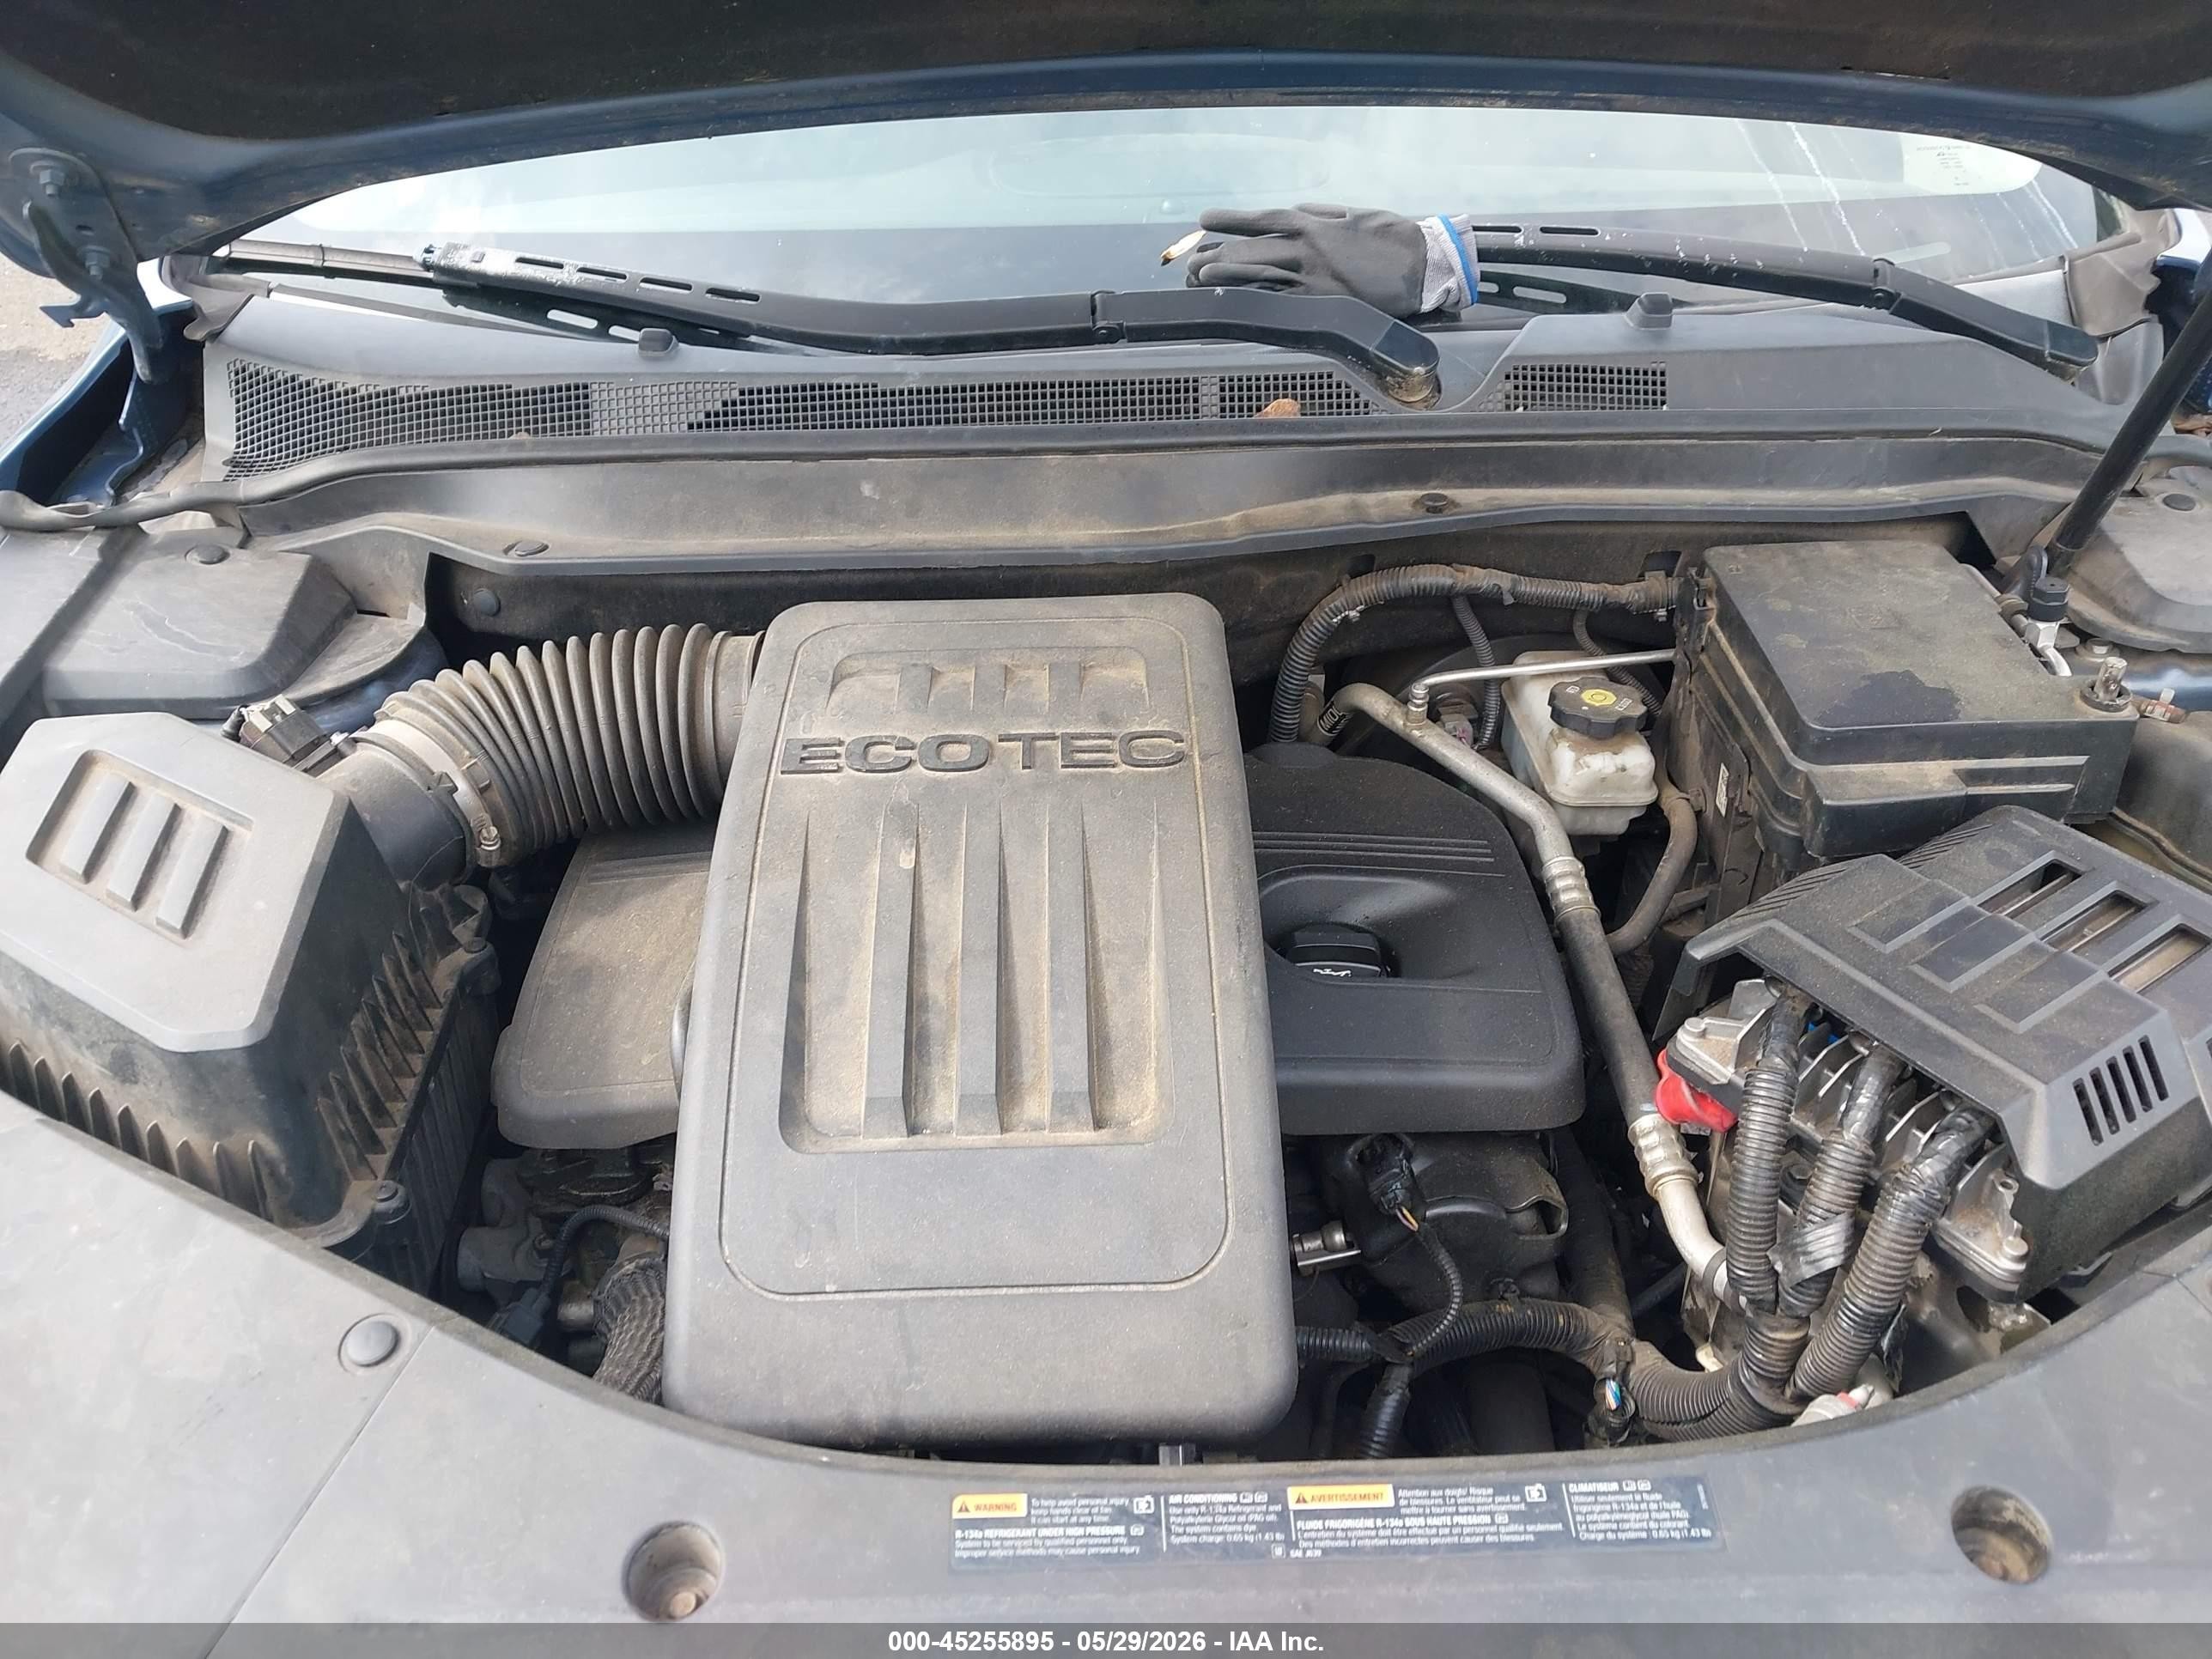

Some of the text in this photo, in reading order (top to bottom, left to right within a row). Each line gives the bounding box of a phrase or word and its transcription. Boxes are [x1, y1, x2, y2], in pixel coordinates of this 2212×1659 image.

[780, 729, 1185, 775] ECOTEC
[1569, 1481, 1620, 1493] CLIMATISEUR
[1169, 1492, 1237, 1504] AIR CONDITIONING
[1310, 1492, 1384, 1503] AVERTISSEMENT
[975, 1502, 1018, 1512] WARNING
[1297, 1520, 1323, 1530] FLUIDE
[1376, 1518, 1404, 1528] R-134a
[1404, 1516, 1425, 1528] SOUS
[1426, 1516, 1451, 1526] HAUTE
[1452, 1514, 1492, 1526] PRESSION
[984, 1527, 1036, 1539] REFRIGERANT
[1037, 1527, 1065, 1538] UNDER
[1065, 1526, 1085, 1537] HIGH
[1085, 1525, 1125, 1536] PRESSURE
